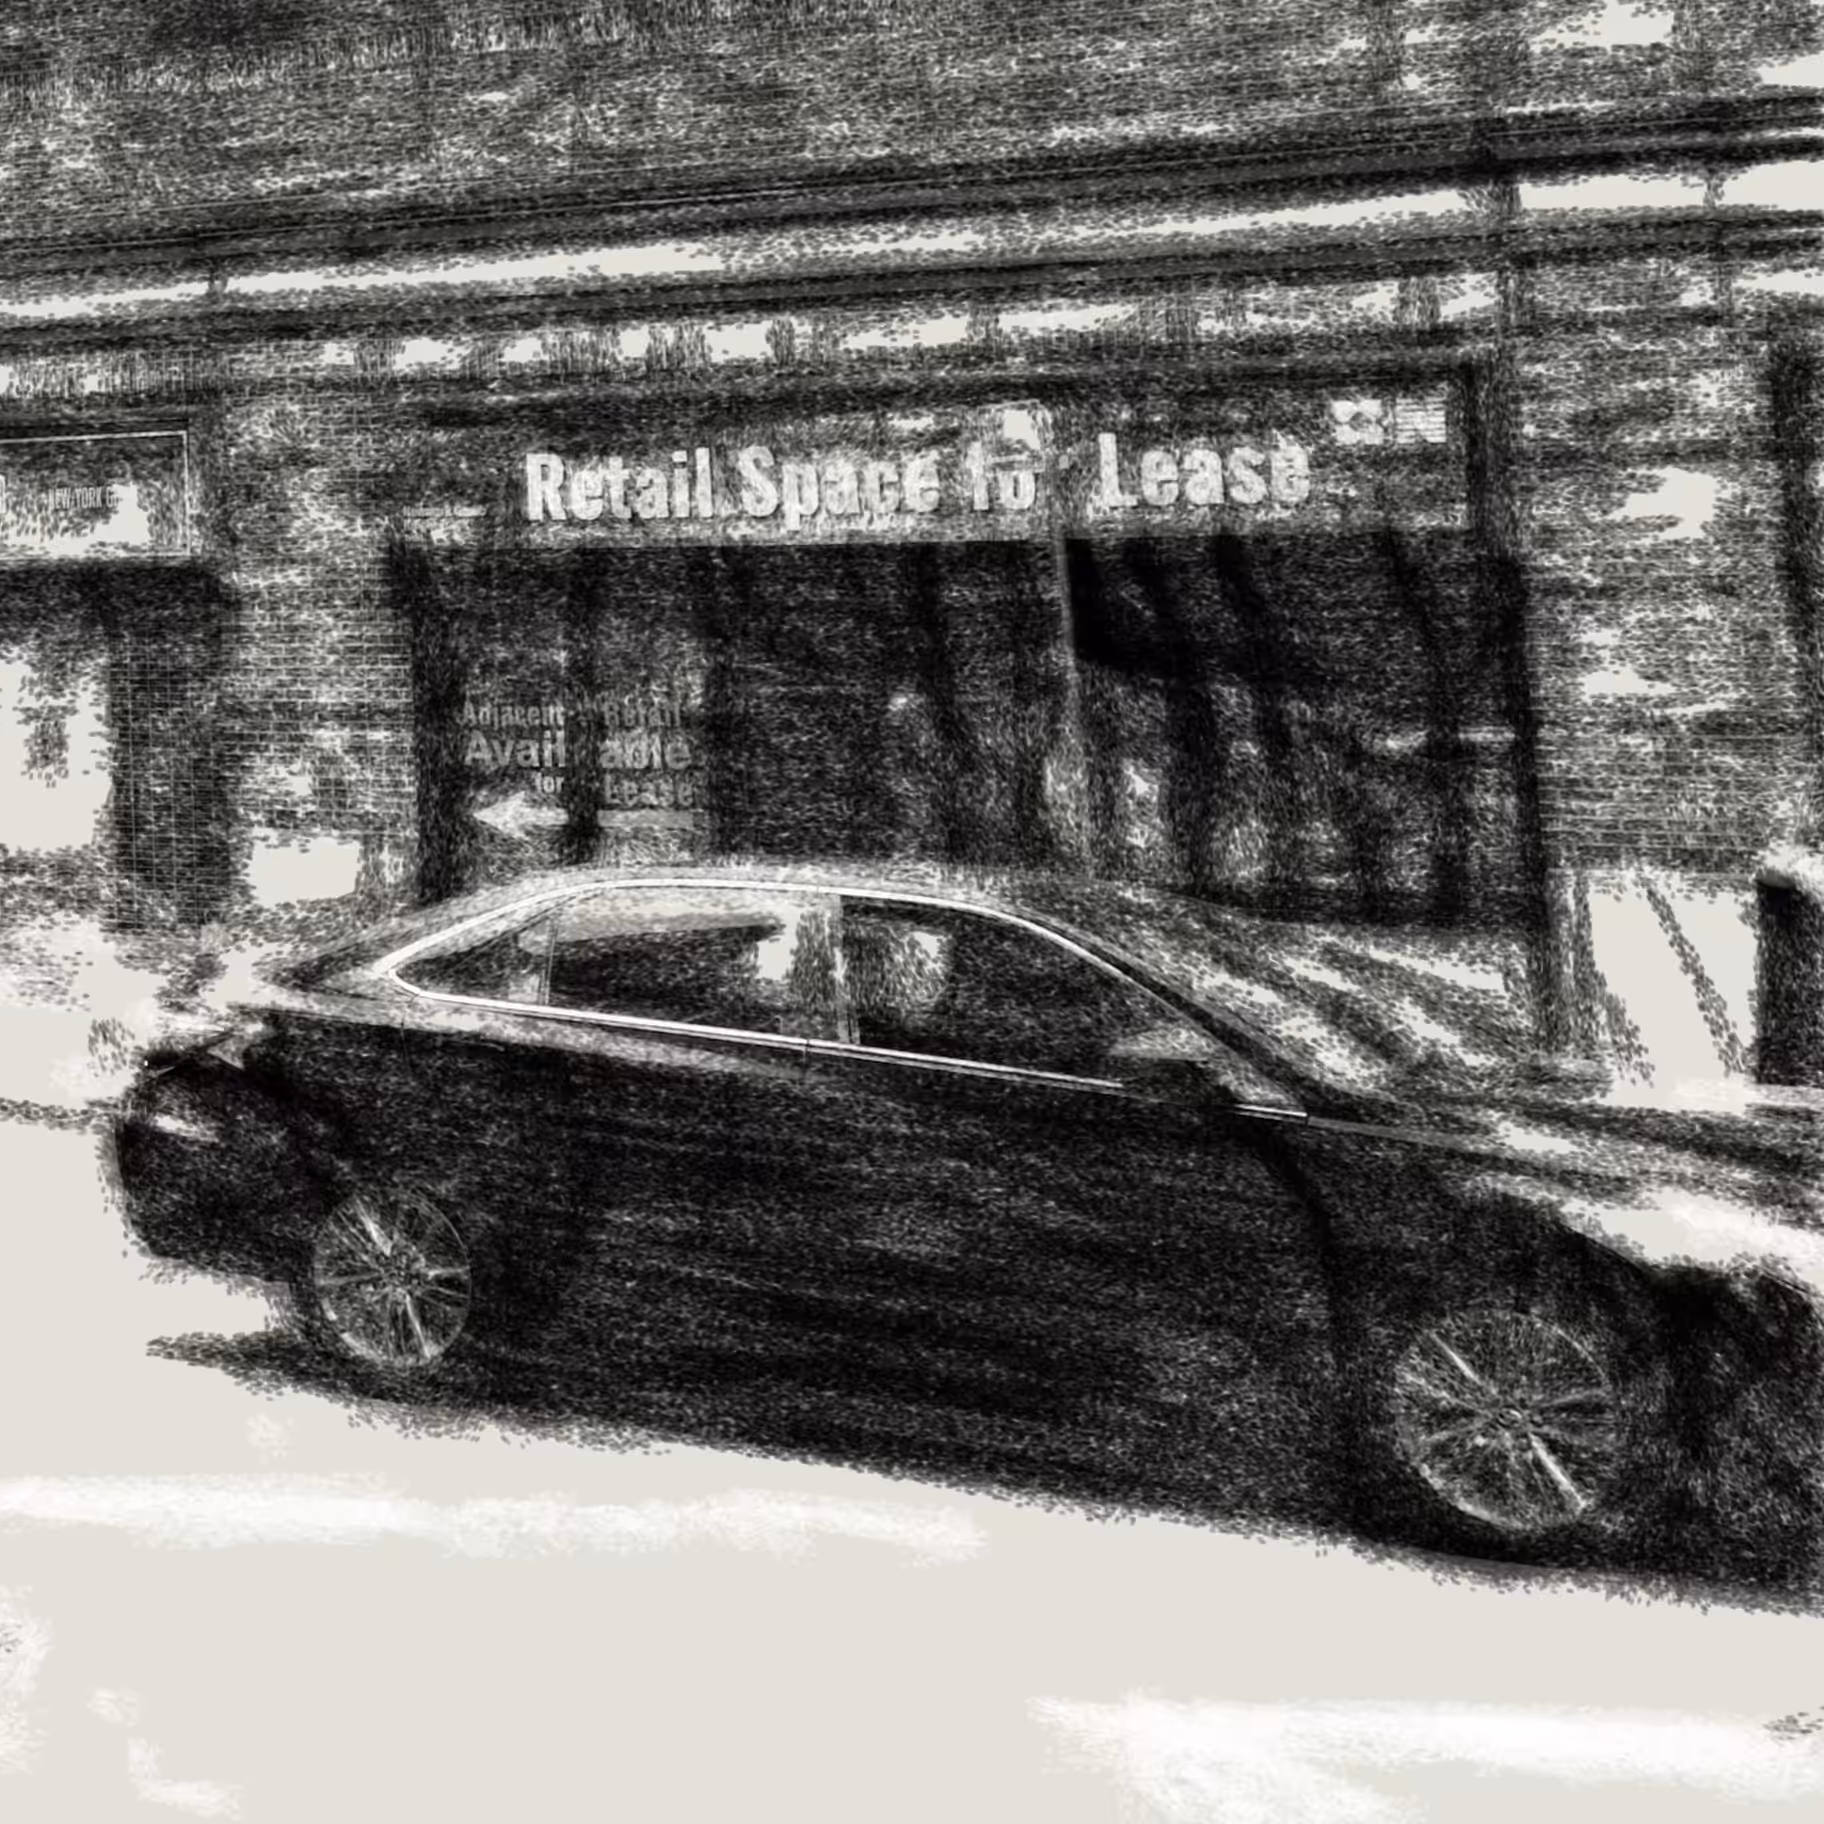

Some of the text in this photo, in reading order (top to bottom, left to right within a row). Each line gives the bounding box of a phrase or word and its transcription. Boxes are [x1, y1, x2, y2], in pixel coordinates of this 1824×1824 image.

[74, 486, 102, 509] YORK
[524, 446, 715, 523] Retail
[738, 444, 941, 532] Space
[1095, 432, 1312, 508] Lease
[603, 773, 695, 806] Lease
